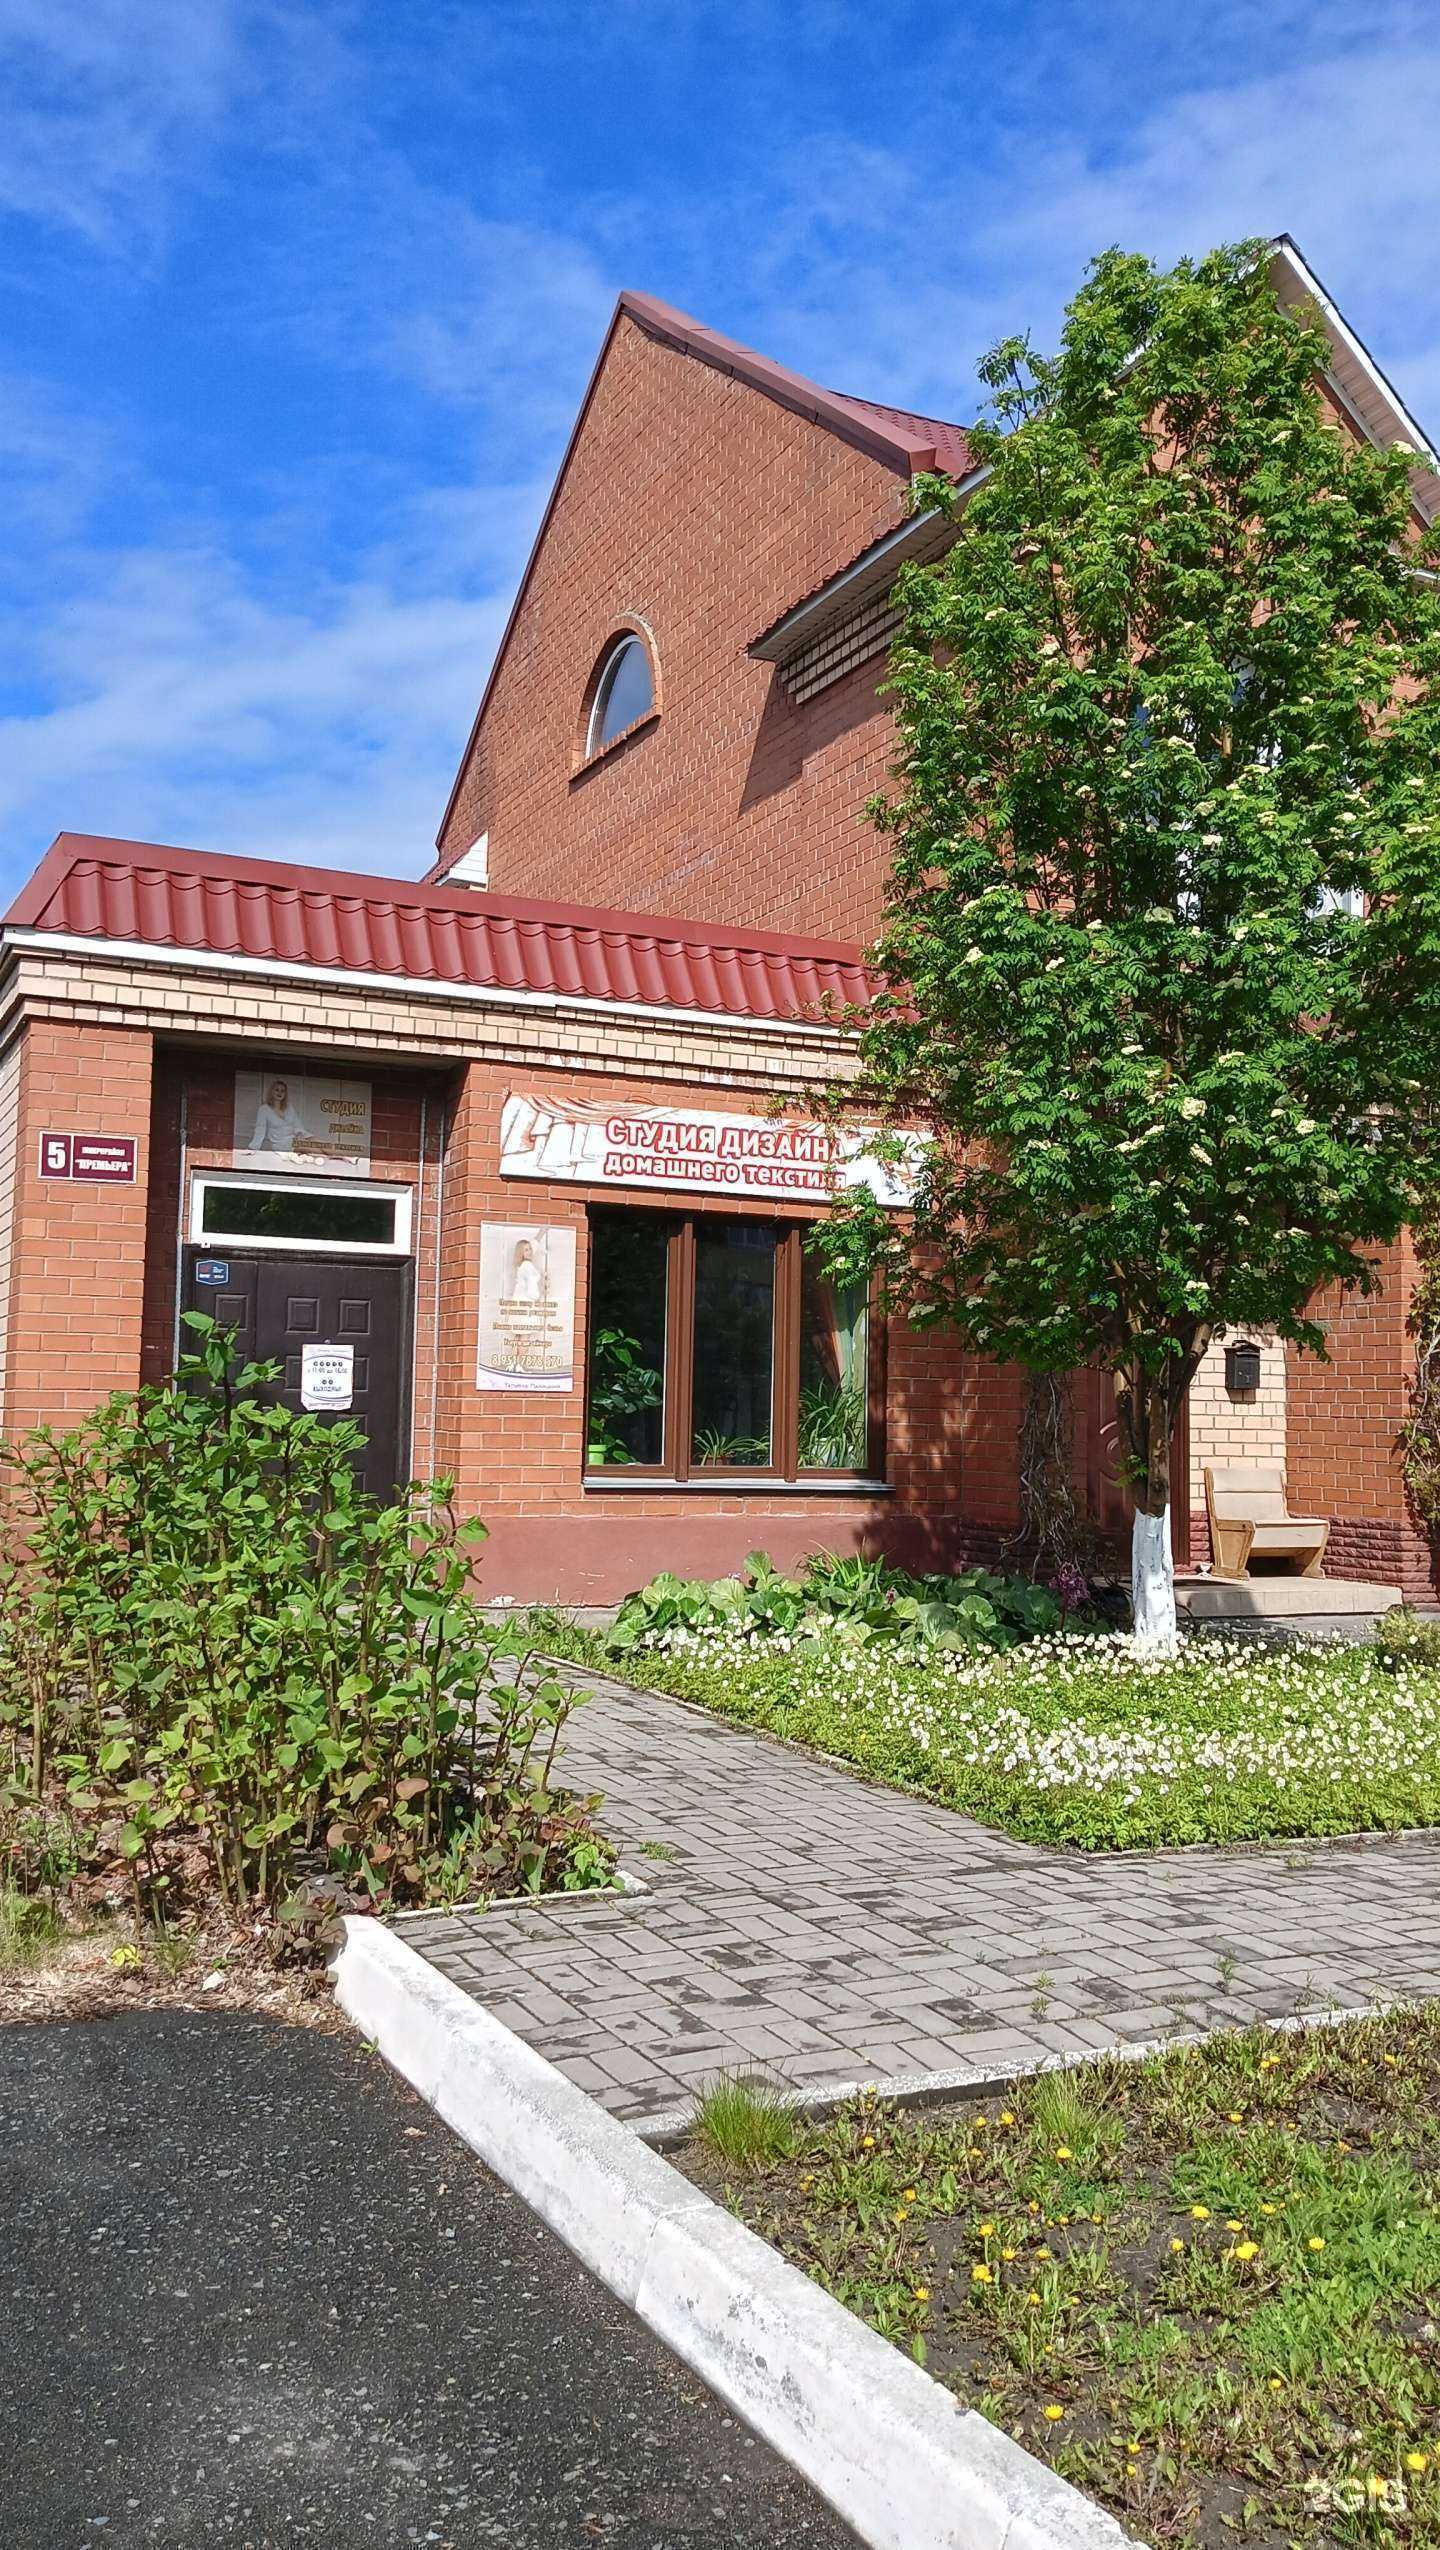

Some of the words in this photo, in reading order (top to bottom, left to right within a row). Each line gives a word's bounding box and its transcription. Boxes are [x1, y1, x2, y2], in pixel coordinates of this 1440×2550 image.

[320, 1099, 365, 1116] СТУДИЯ
[47, 1141, 66, 1170] 5
[606, 1117, 716, 1154] СТУДИЯ
[718, 1126, 847, 1165] ДИЗАЙНА
[604, 1152, 740, 1183] домашнего
